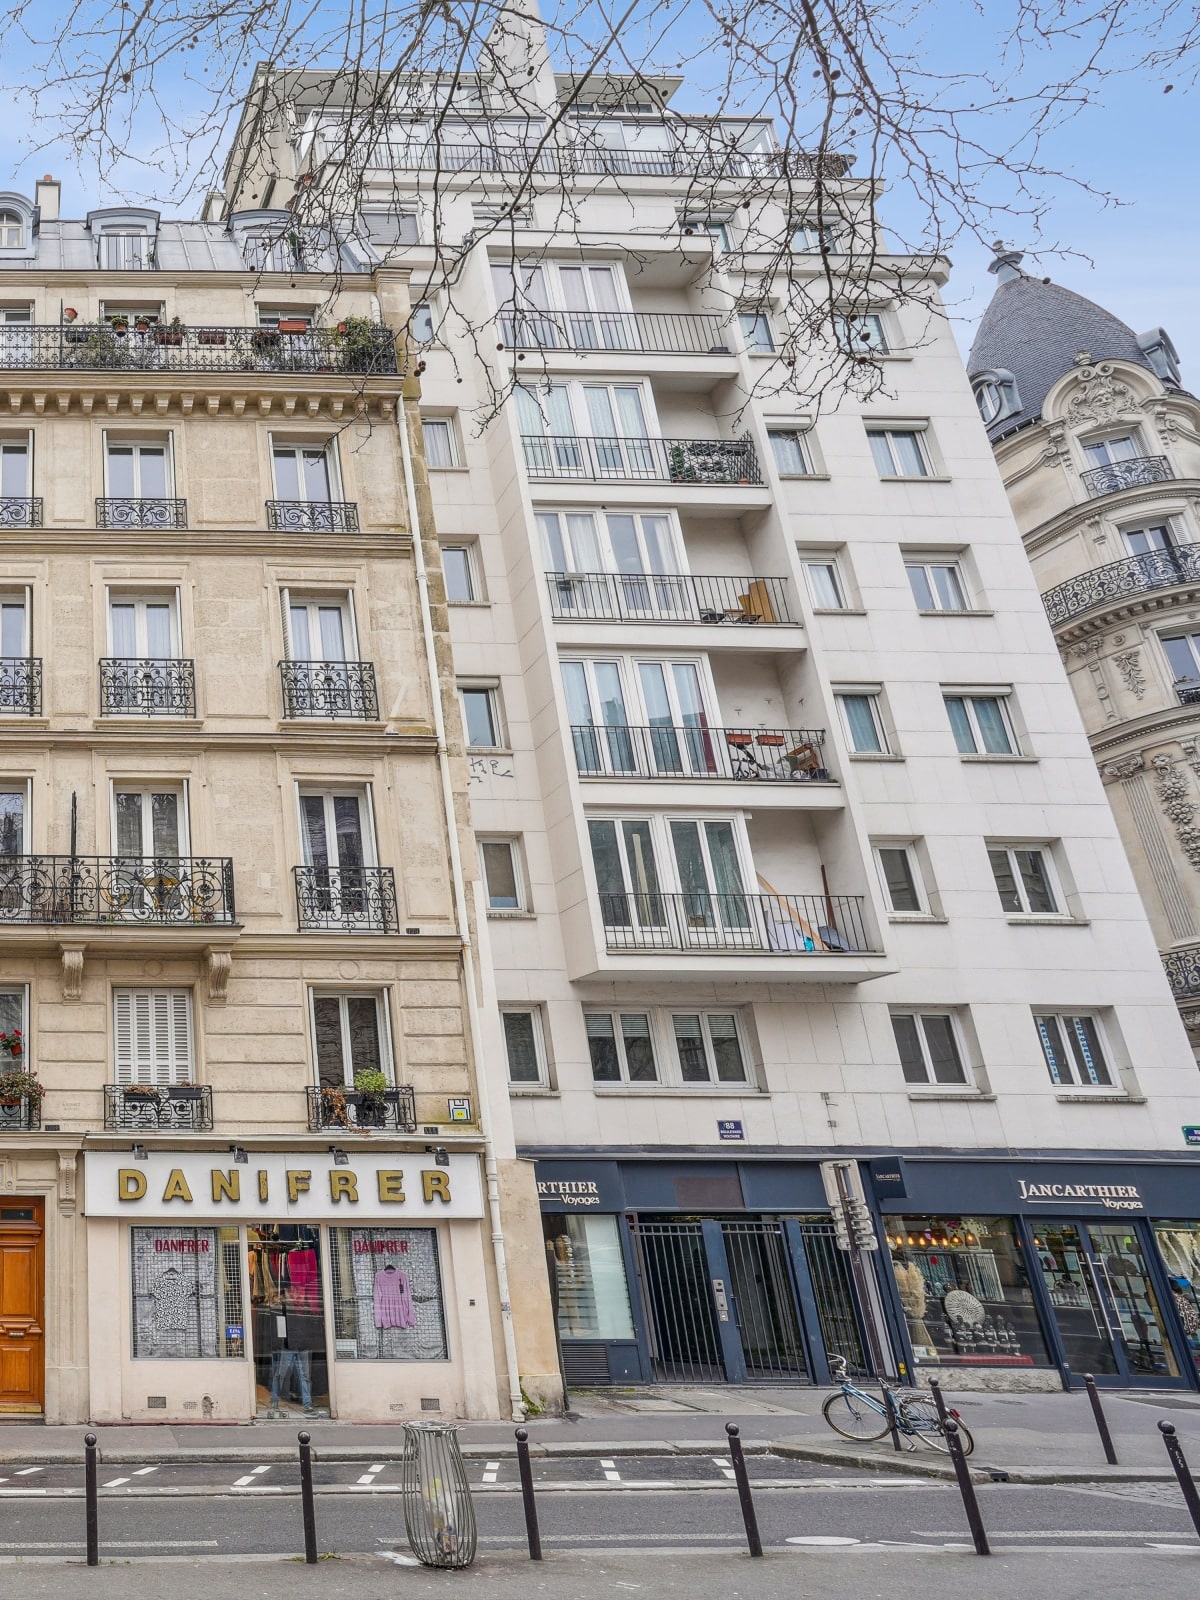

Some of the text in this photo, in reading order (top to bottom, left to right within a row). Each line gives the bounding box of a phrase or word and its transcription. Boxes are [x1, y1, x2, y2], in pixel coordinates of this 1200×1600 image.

[118, 1168, 451, 1203] DANIFRER
[537, 1182, 598, 1193] RTHIER
[561, 1194, 600, 1205] Voyages
[1101, 1198, 1143, 1210] Voyages
[155, 1239, 209, 1252] DANIFRER
[354, 1240, 408, 1253] DANIFRER
